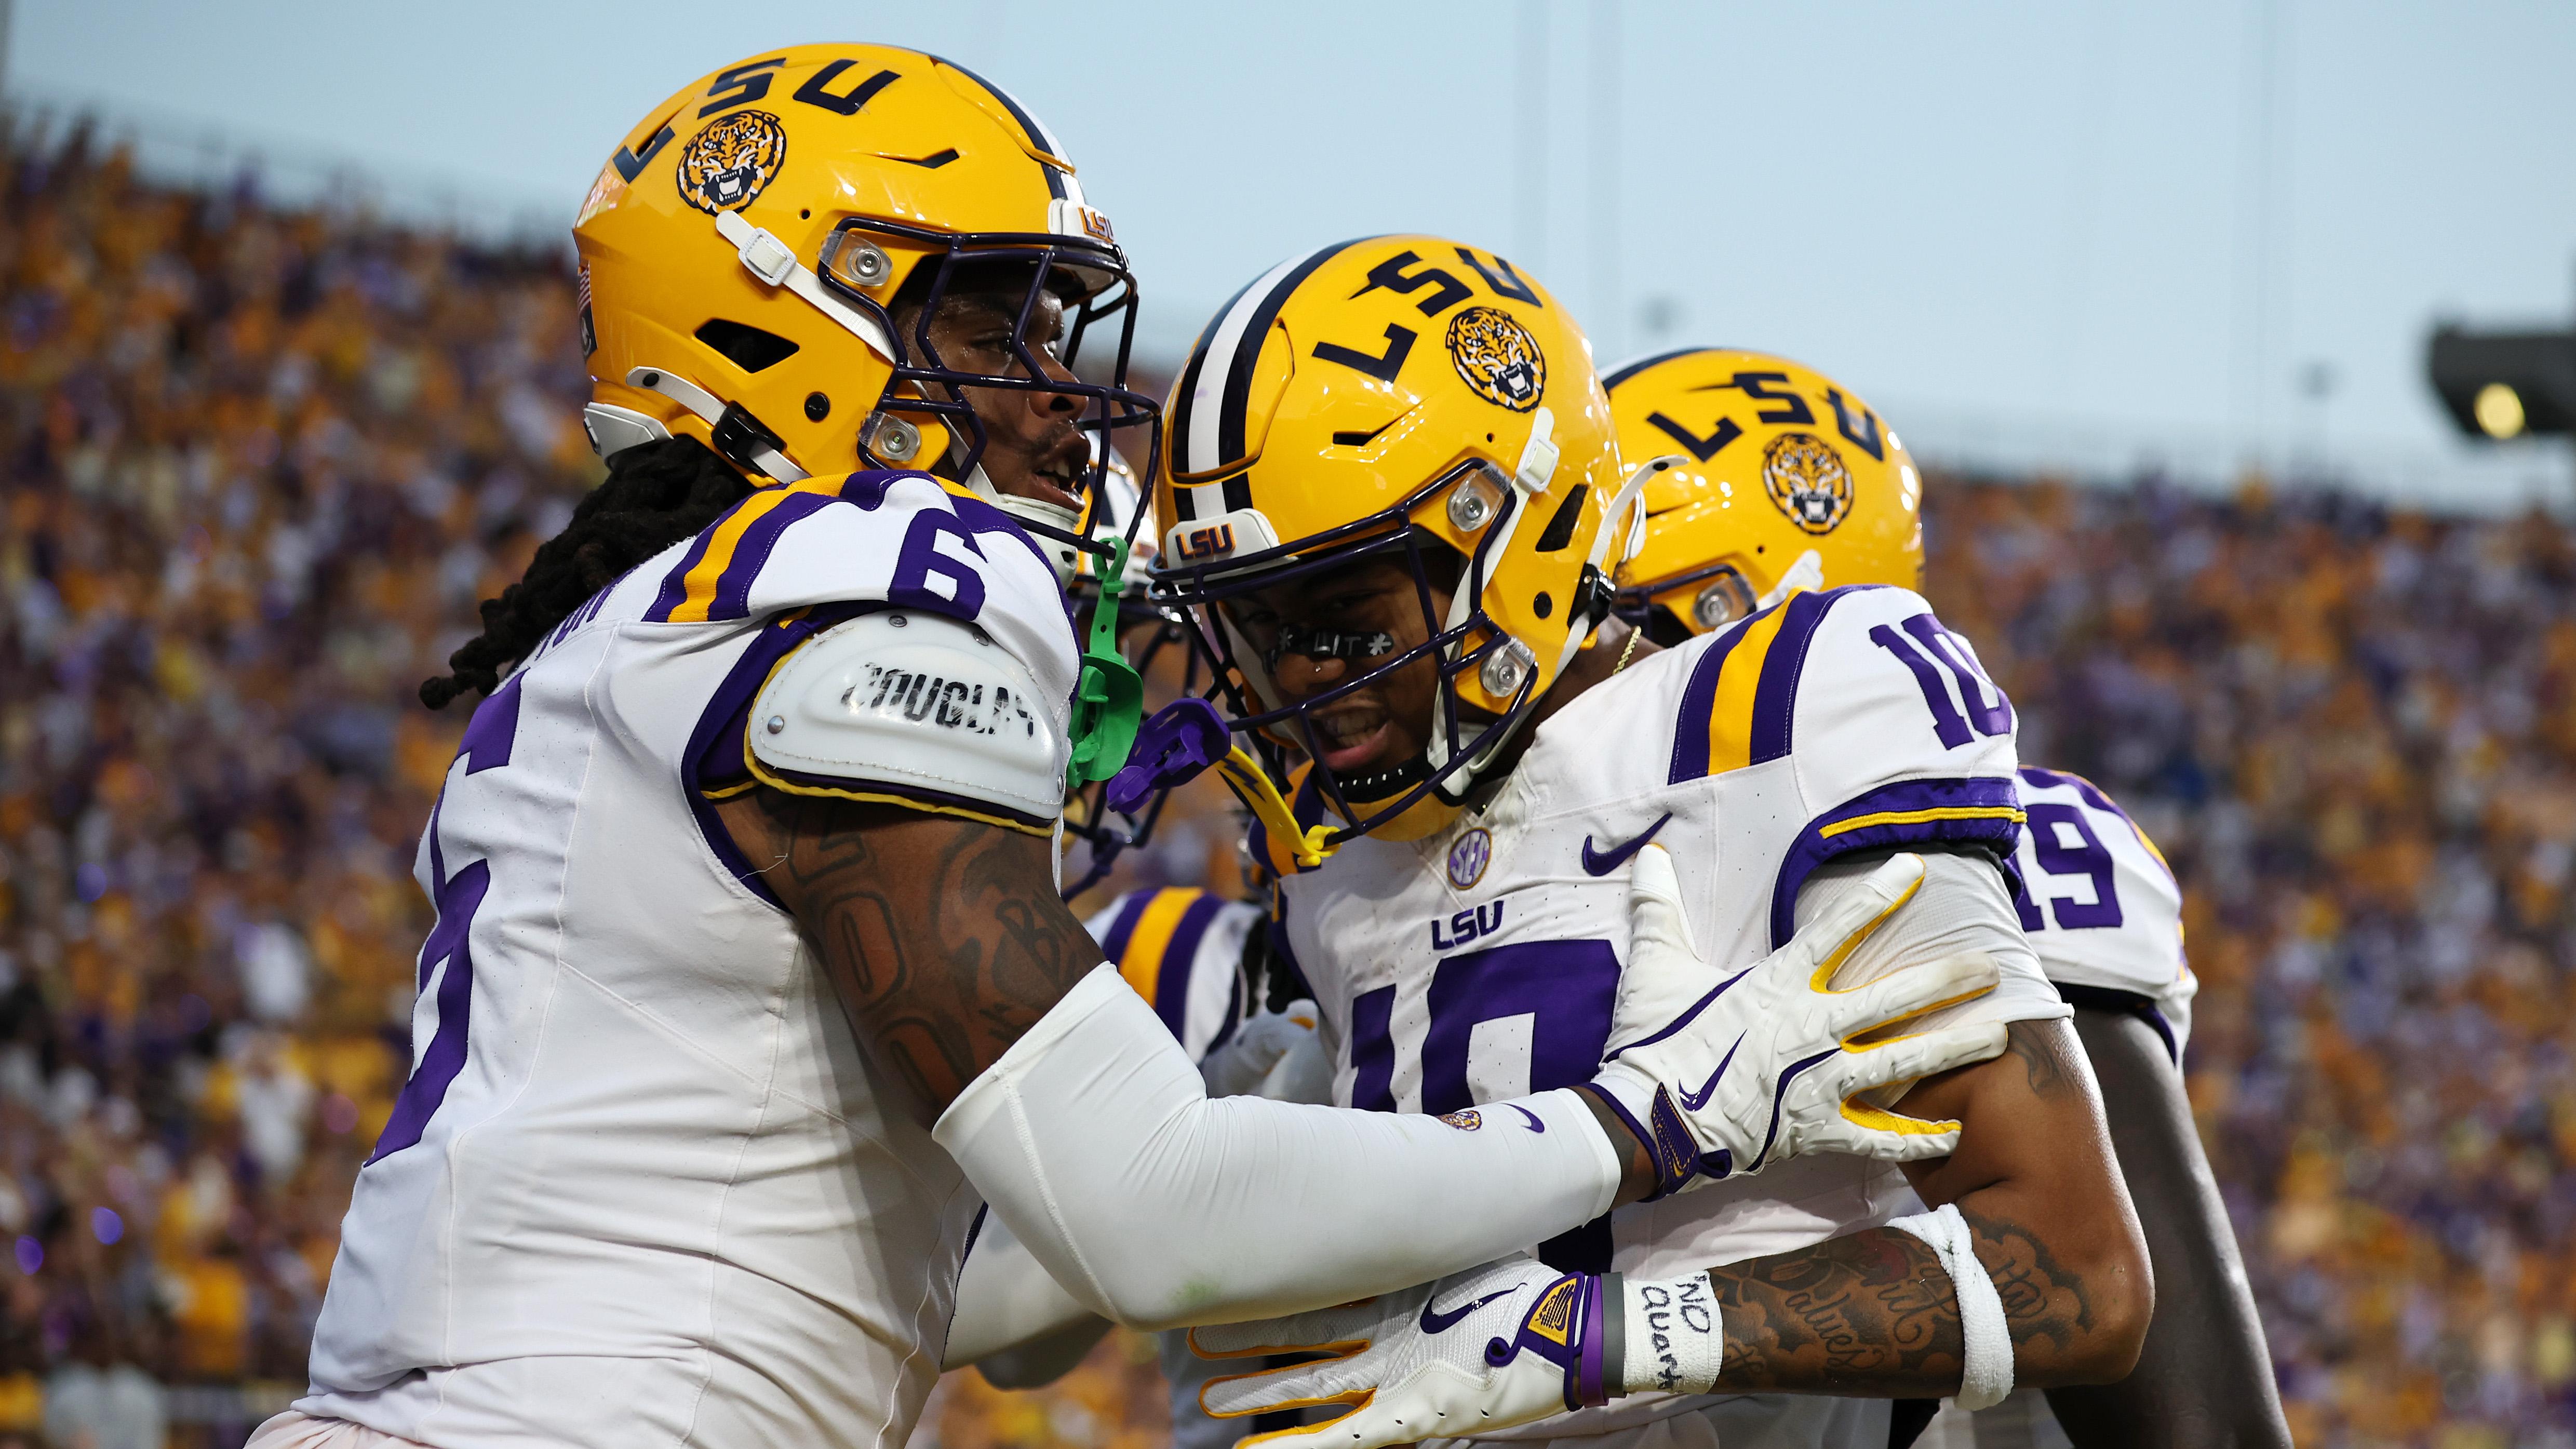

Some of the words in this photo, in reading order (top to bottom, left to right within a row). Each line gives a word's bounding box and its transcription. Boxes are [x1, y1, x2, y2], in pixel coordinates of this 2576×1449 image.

[613, 58, 902, 183] LSU
[1312, 247, 1544, 383] LSU
[1645, 372, 1884, 462] LSU
[888, 508, 987, 621] 6
[1175, 524, 1238, 560] LSU
[1869, 613, 2013, 750] 10
[1431, 900, 1504, 950] LSU
